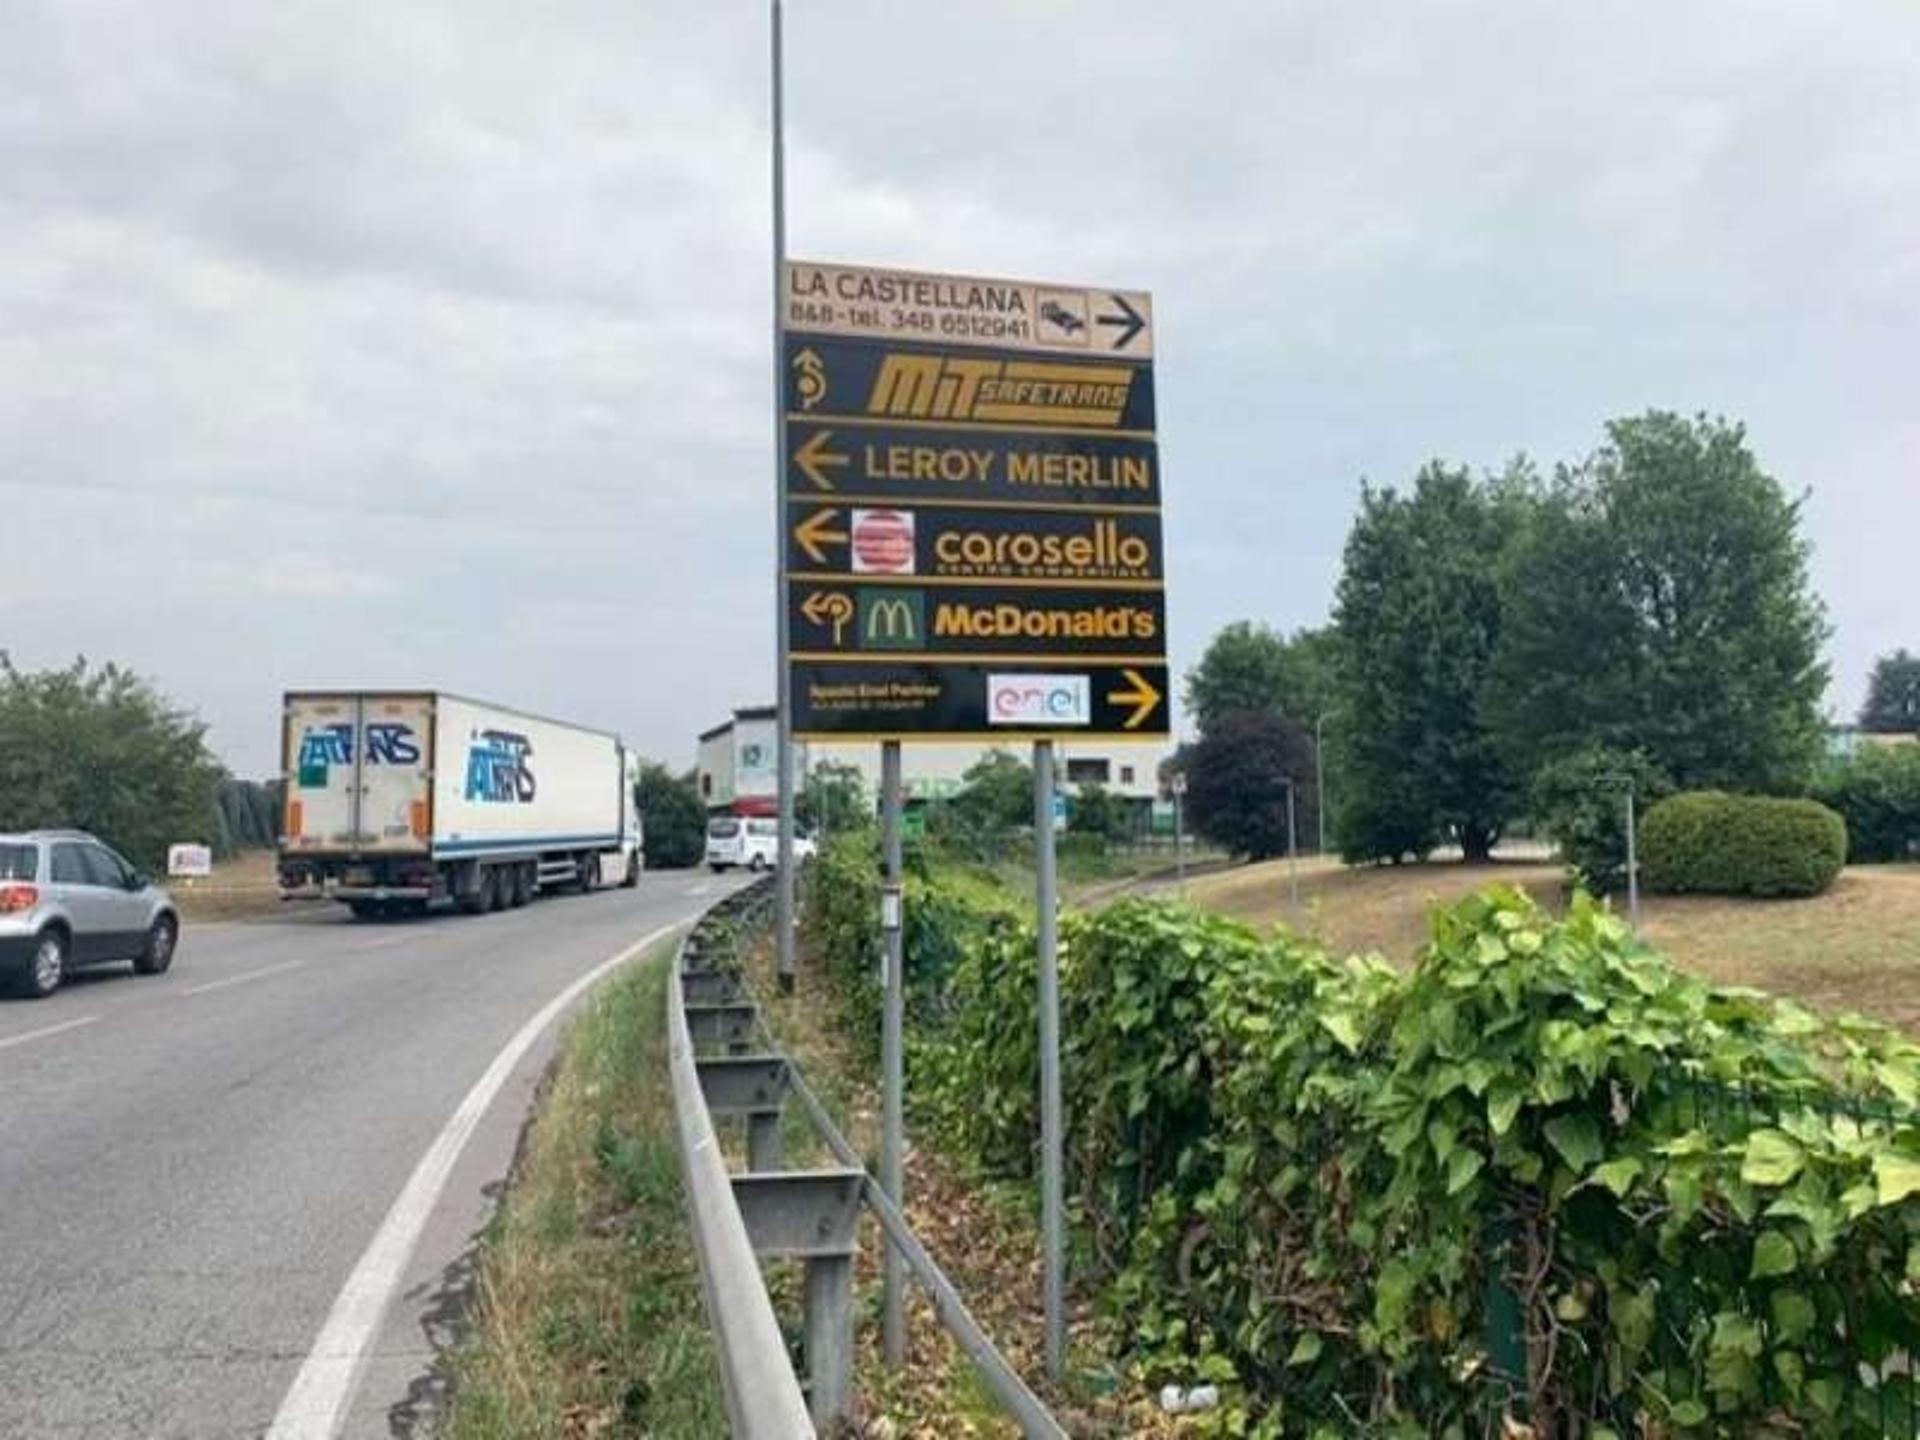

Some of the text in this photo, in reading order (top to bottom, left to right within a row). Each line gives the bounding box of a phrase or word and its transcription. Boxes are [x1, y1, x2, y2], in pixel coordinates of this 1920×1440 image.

[791, 268, 1026, 313] LA CASTELLANA
[891, 309, 934, 331] 348
[940, 313, 1030, 337] 6512941
[865, 445, 1149, 488] LEROY MERLIN
[935, 519, 1149, 567] carosello
[935, 604, 1156, 638] McDonald's
[995, 685, 1081, 717] enel
